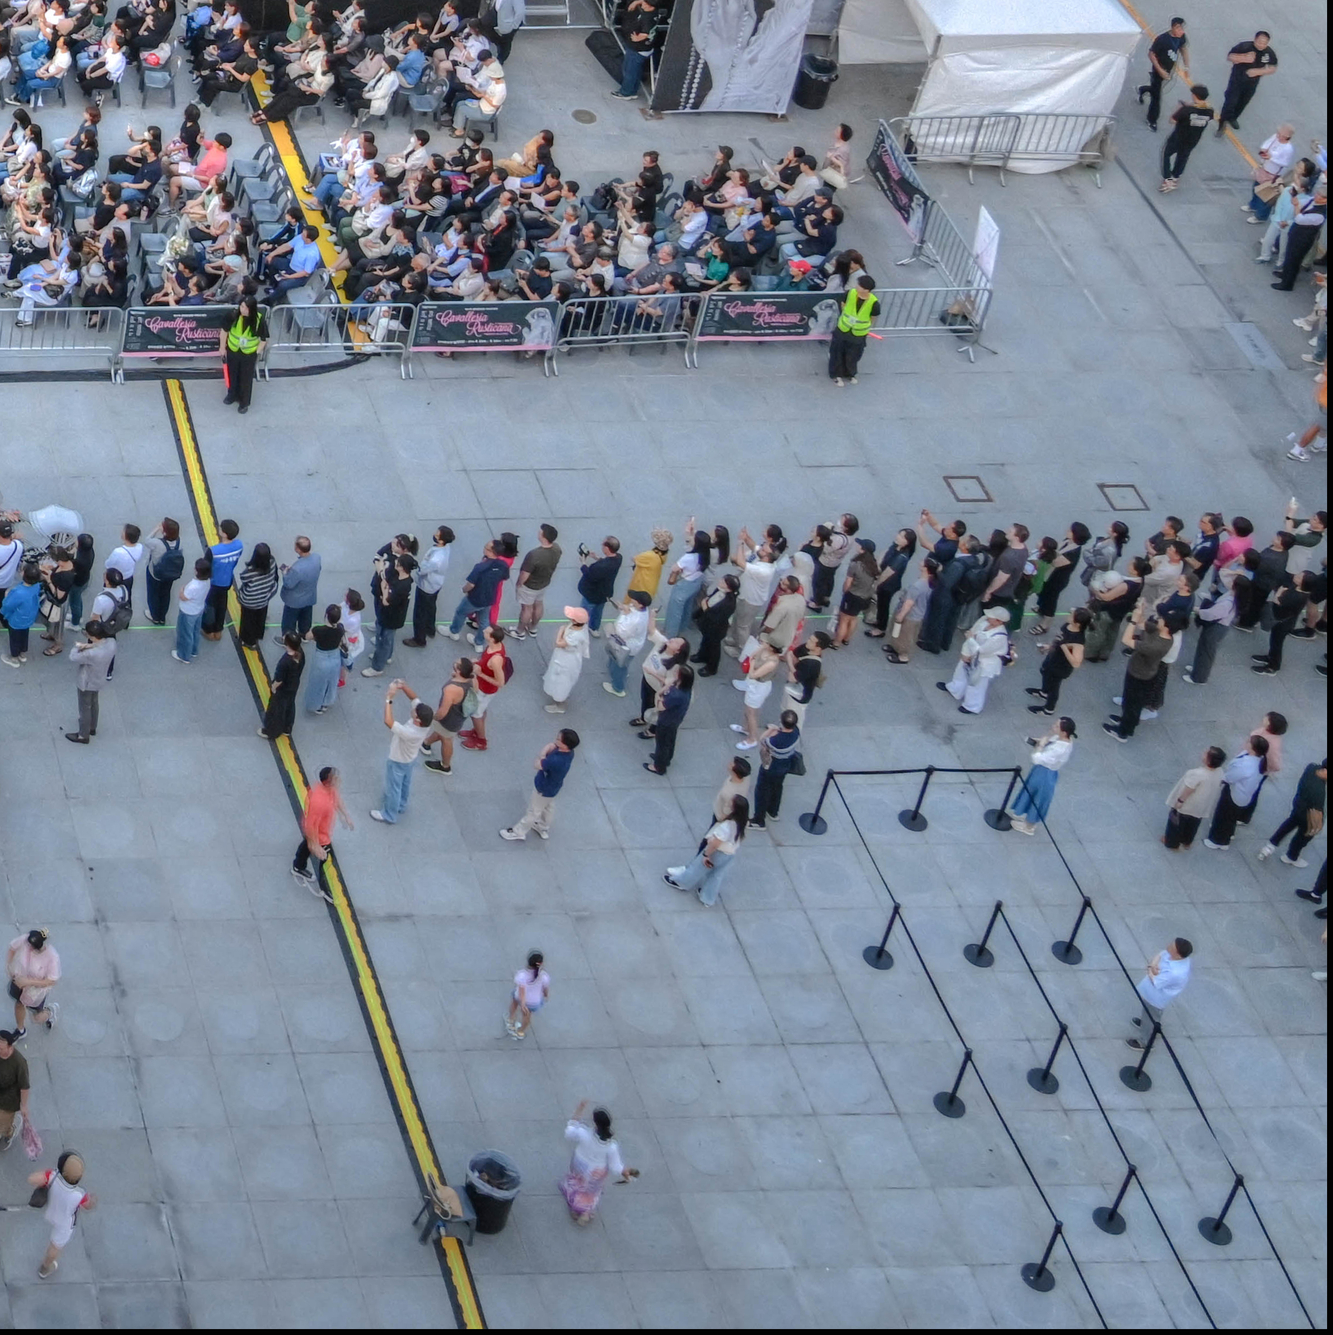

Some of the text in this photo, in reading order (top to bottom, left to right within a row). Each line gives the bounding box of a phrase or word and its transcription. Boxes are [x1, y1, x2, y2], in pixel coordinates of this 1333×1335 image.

[145, 316, 197, 334] Cavalleria
[436, 310, 488, 327] Cavalleria
[465, 321, 521, 337] Rusticana
